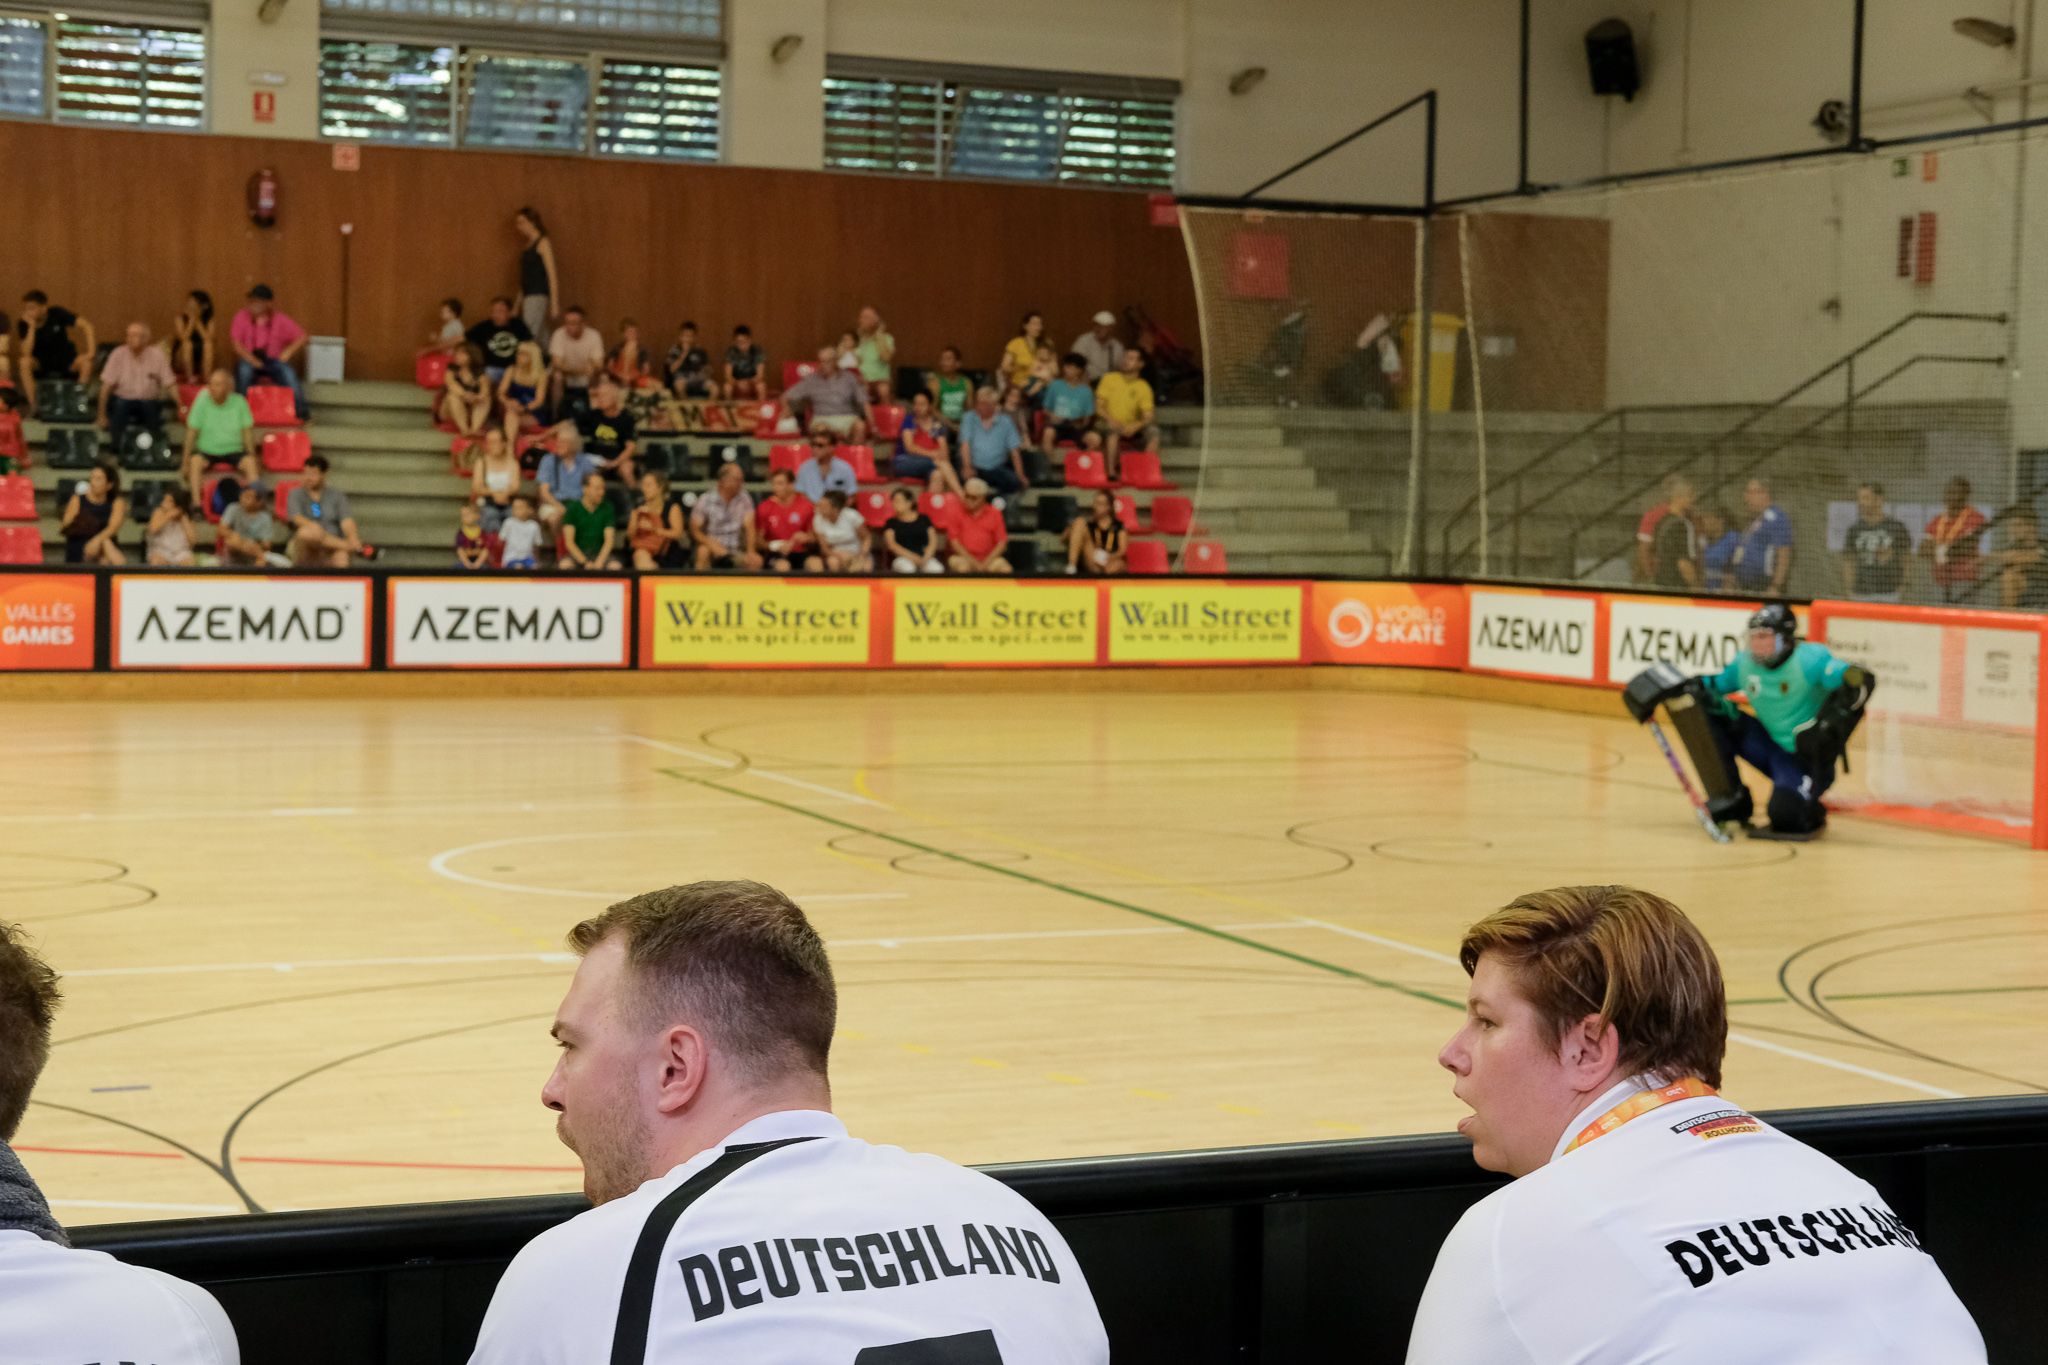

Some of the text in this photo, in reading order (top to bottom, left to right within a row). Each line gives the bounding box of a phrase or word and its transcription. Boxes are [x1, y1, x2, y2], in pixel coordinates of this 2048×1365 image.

[137, 605, 344, 642] AZEMAD
[410, 606, 604, 641] AZEMAD
[665, 600, 860, 629] Wall Street
[905, 601, 1088, 629] Wall Street
[1119, 601, 1292, 629] Wall Street
[1376, 605, 1446, 623] WORLD
[2, 625, 75, 645] GAMES
[1375, 623, 1446, 645] SKATE
[1478, 615, 1583, 656] AZEMAD
